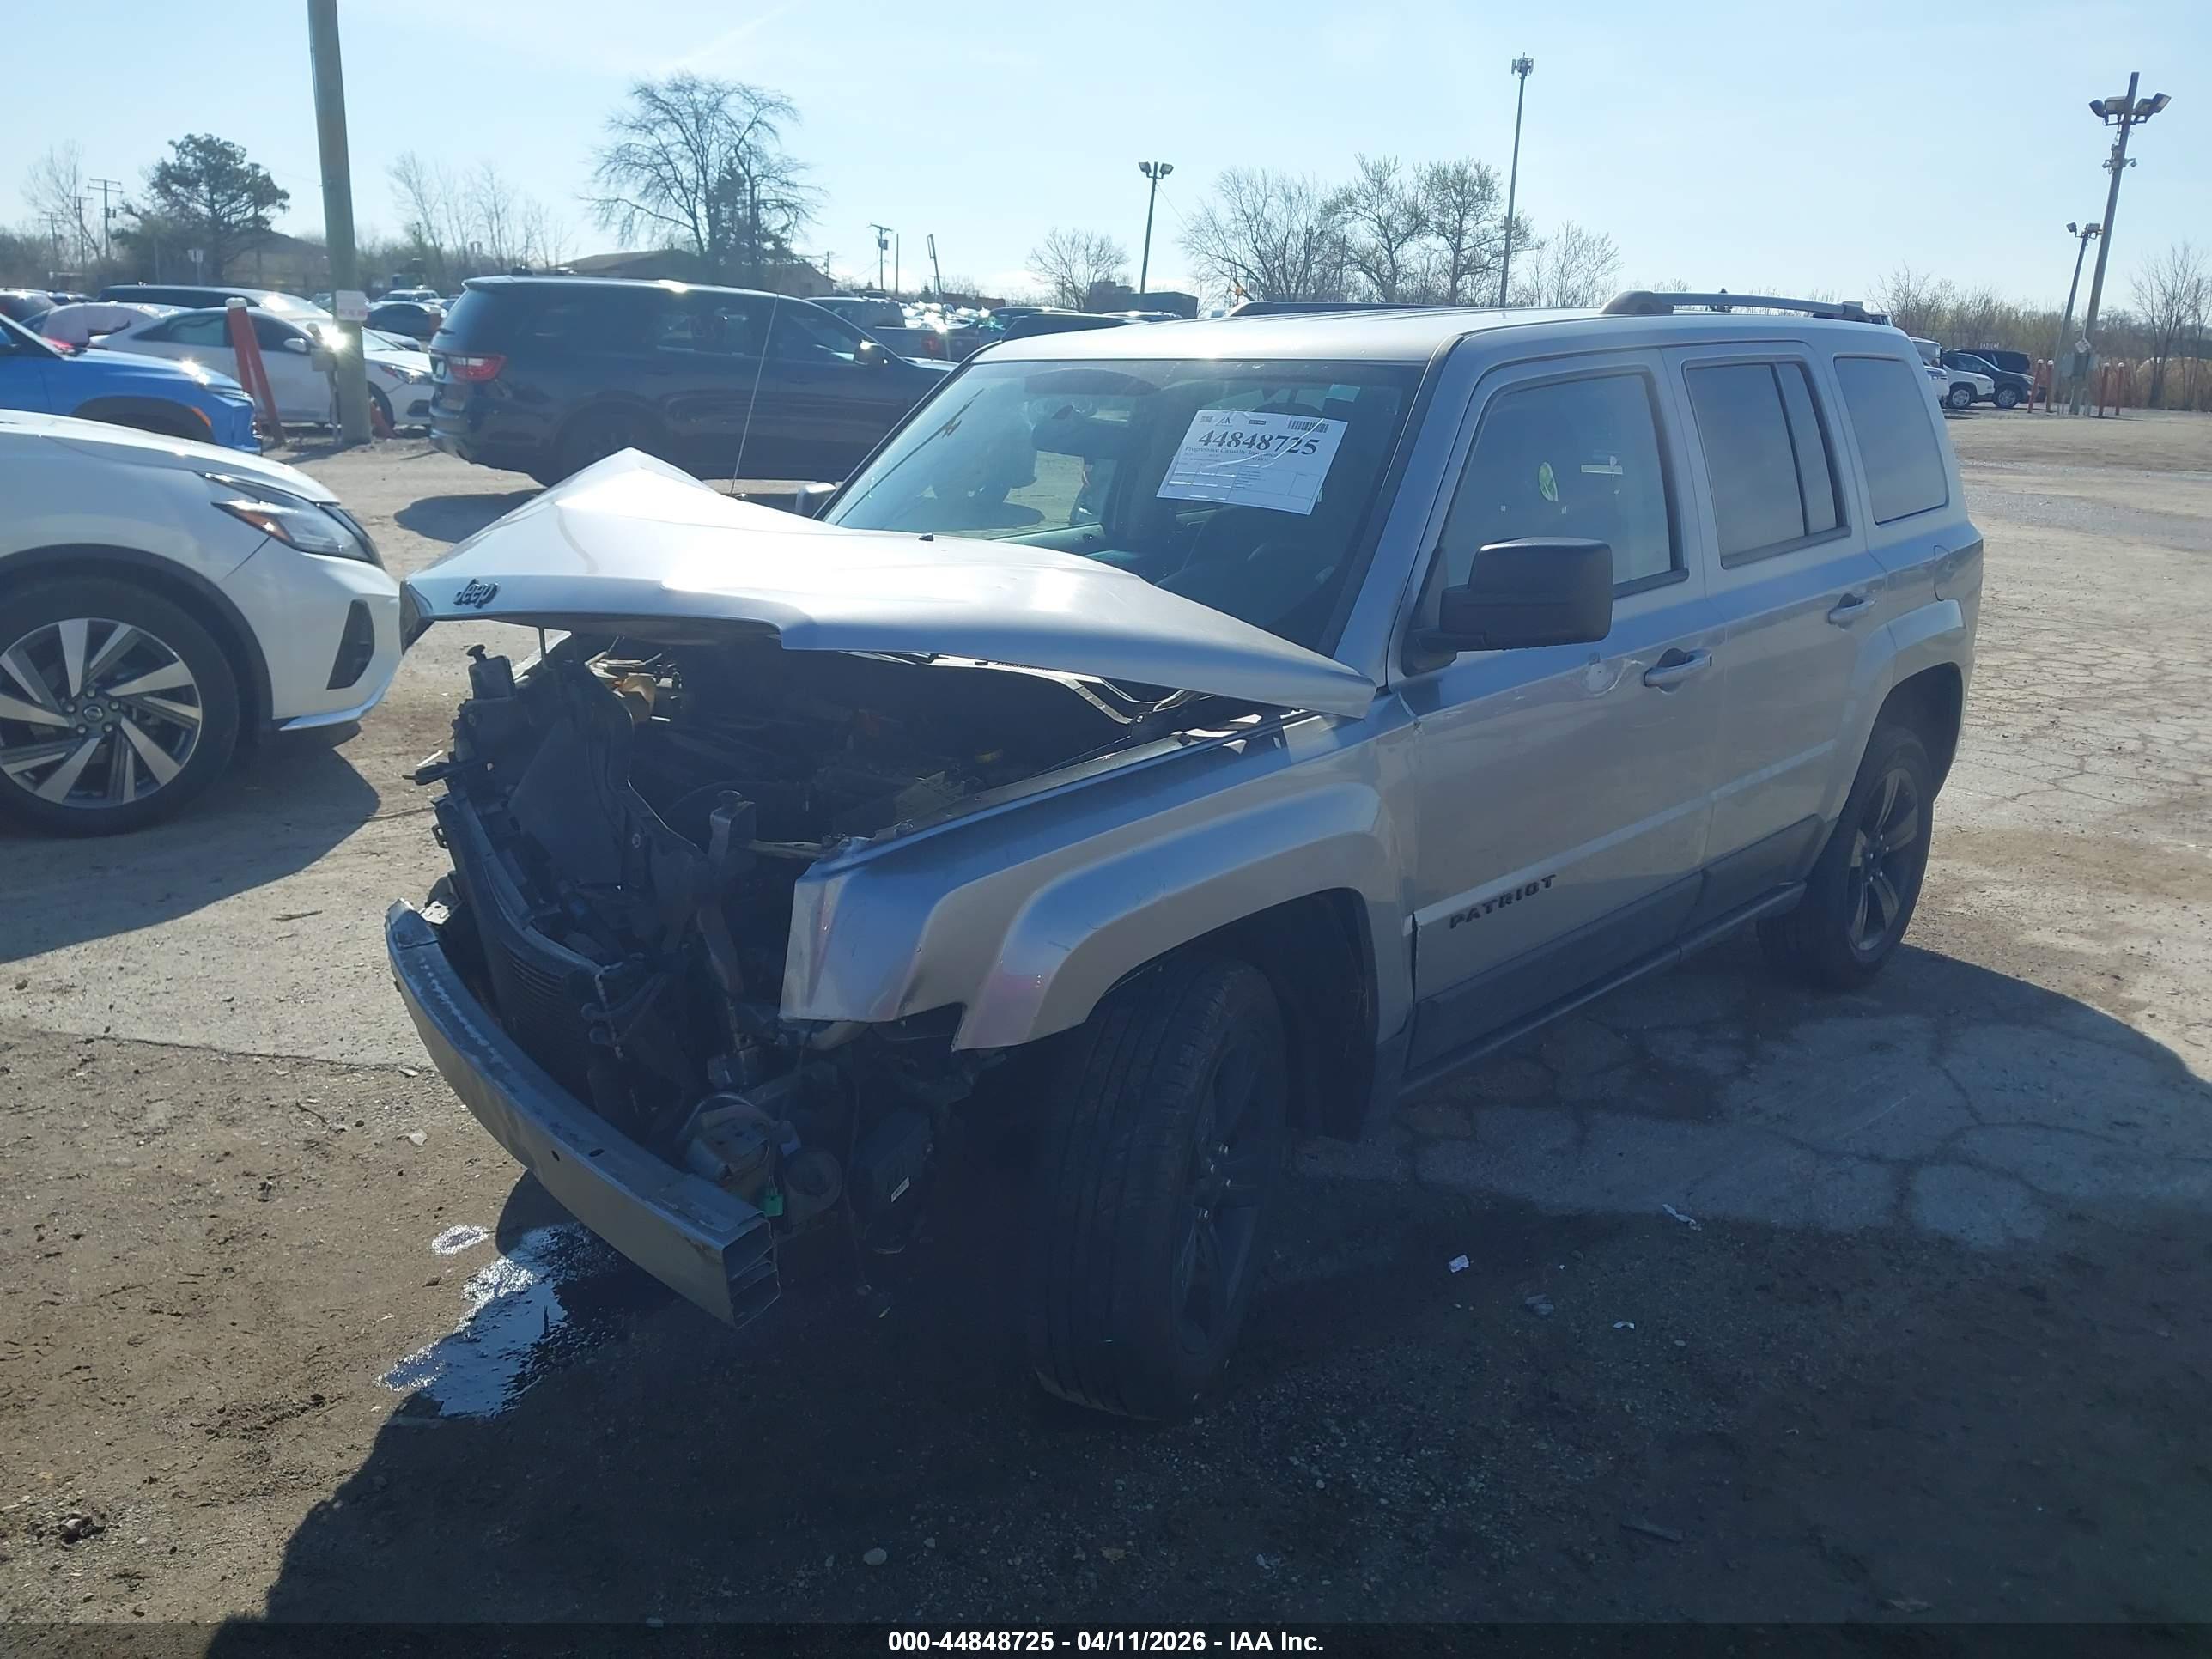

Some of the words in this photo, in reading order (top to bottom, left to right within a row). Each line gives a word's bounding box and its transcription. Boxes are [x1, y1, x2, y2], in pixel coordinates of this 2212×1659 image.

[1198, 429, 1320, 455] 44848725
[453, 578, 500, 609] Jeep
[1449, 874, 1556, 929] PATRIOT
